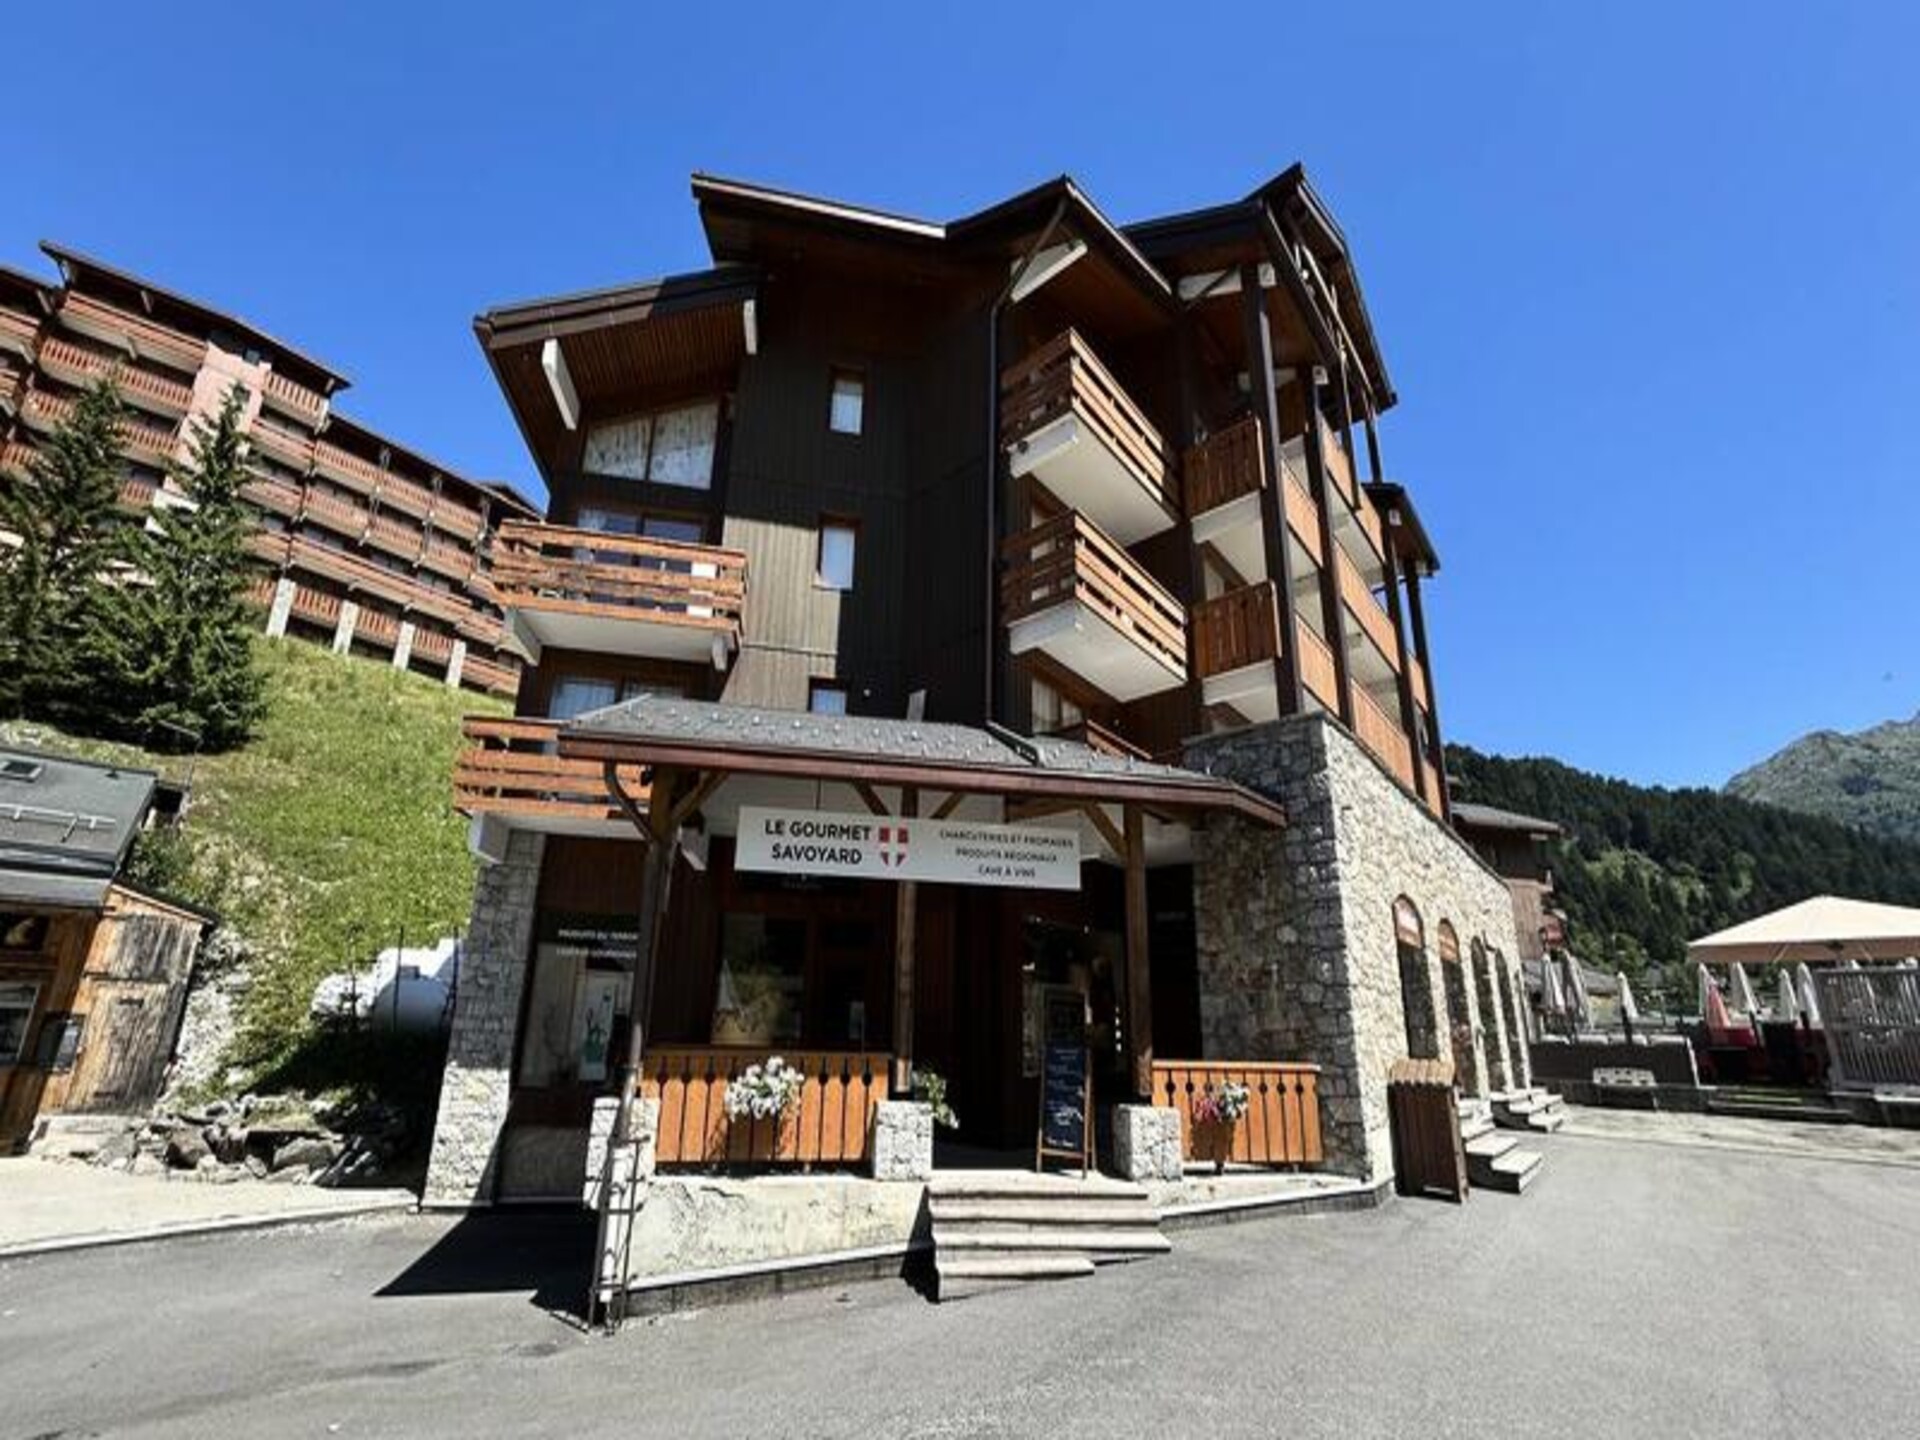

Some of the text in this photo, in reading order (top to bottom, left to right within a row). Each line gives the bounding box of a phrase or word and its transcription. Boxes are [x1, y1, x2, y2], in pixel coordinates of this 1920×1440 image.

[765, 819, 872, 840] LE GOURMET
[1024, 836, 1073, 848] FROMAGES
[771, 842, 863, 864] SAVOYARD
[956, 848, 1001, 858] PRODUITS
[979, 865, 1001, 876] CAVE
